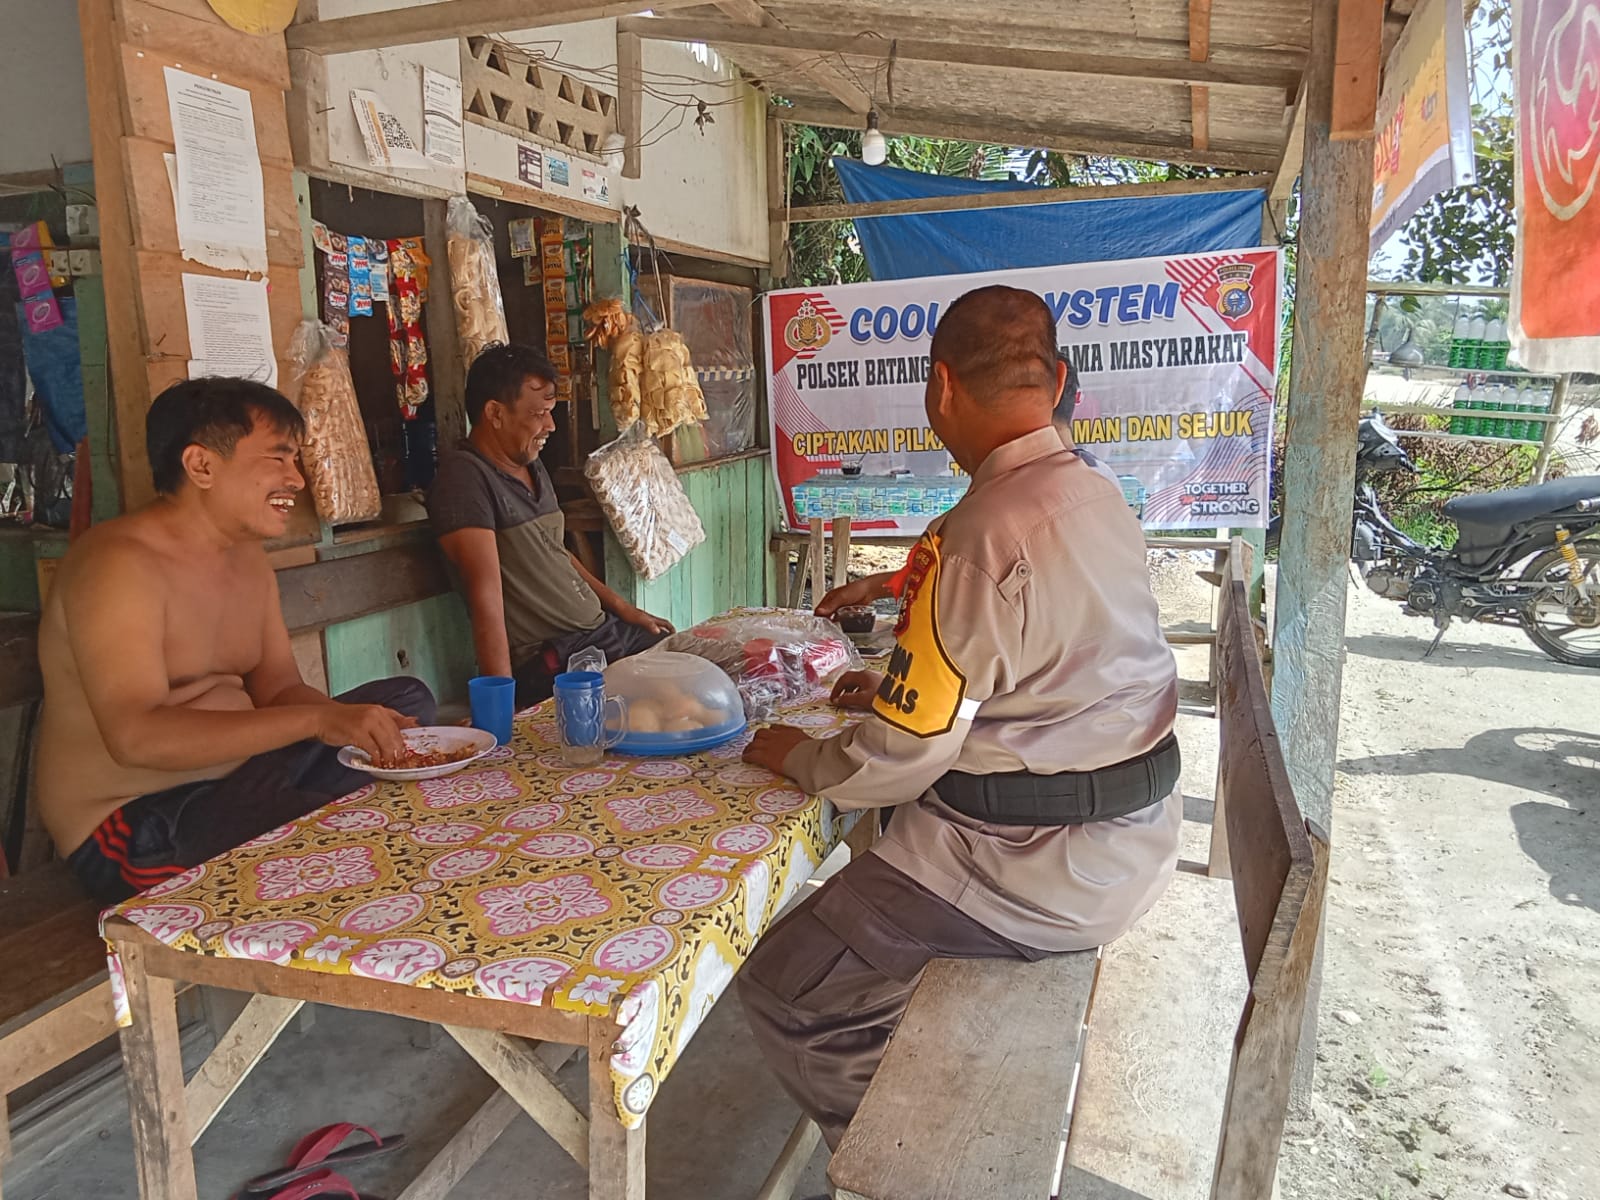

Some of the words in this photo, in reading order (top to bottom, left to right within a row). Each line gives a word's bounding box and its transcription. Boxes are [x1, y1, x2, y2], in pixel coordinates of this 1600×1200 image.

[797, 360, 859, 389] POLSEK
[865, 356, 930, 386] BATANG
[1110, 333, 1246, 370] MASYARAKAT
[793, 430, 888, 456] CIPTAKAN
[1127, 415, 1172, 441] DAN
[1178, 410, 1253, 439] SEJUK
[1185, 482, 1248, 494] TOGETHER
[1191, 499, 1259, 514] STRONG
